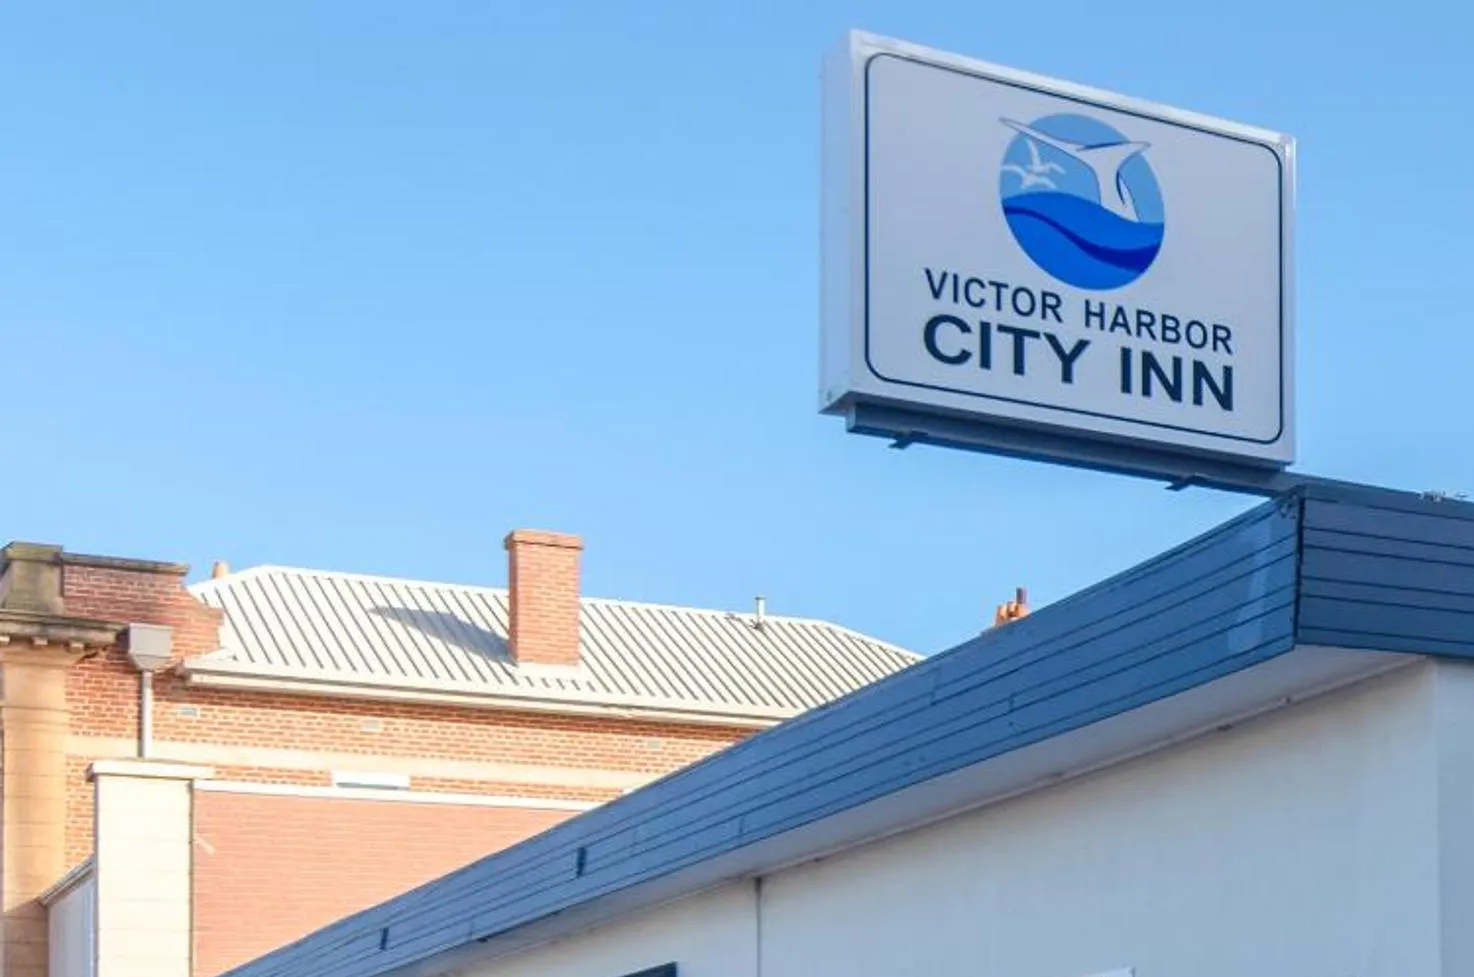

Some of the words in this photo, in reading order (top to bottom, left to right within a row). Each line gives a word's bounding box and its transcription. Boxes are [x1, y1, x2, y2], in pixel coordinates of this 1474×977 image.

[924, 267, 1063, 324] VICTOR
[1085, 299, 1233, 356] HARBOR
[923, 314, 1091, 384] CITY
[1120, 346, 1233, 412] INN
